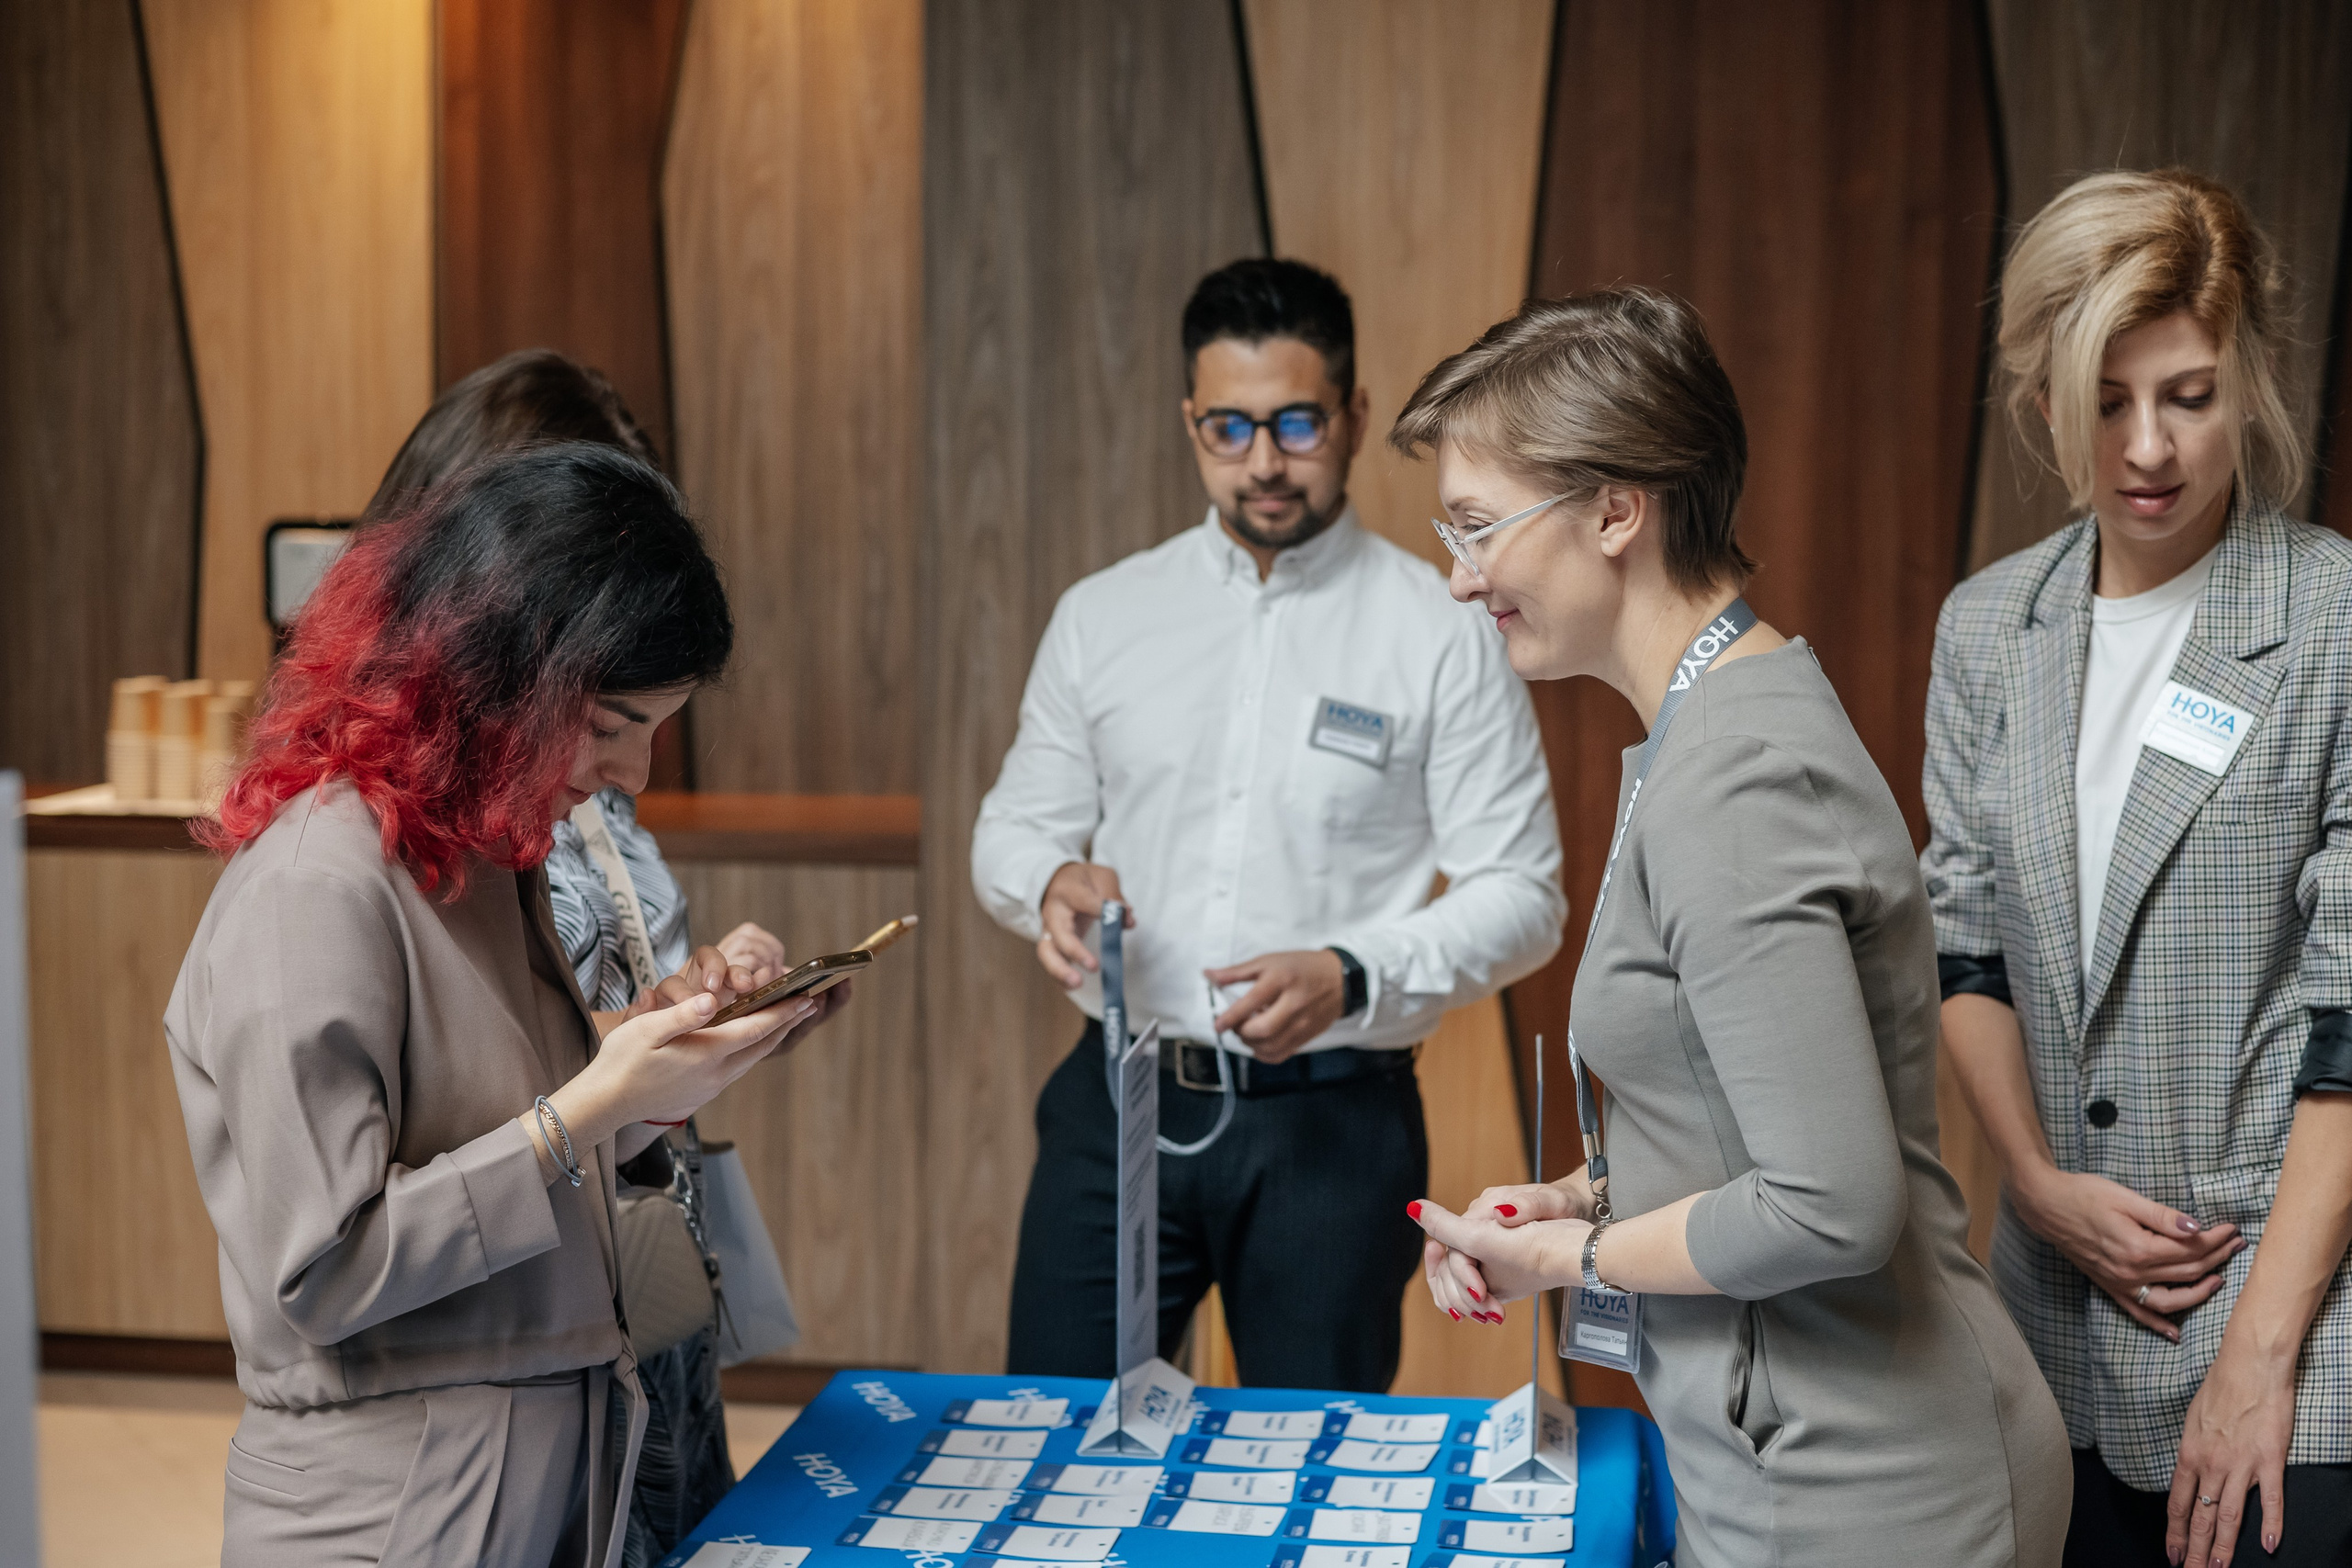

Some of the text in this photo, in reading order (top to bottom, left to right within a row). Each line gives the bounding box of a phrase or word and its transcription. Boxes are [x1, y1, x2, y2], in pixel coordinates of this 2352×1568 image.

[1668, 616, 1739, 693] HOYA
[1327, 704, 1385, 732] HOYA
[2171, 692, 2234, 734] HOYA
[1580, 1288, 1630, 1315] HOYA
[852, 1381, 916, 1423] HOYA
[793, 1453, 859, 1498] HOYA
